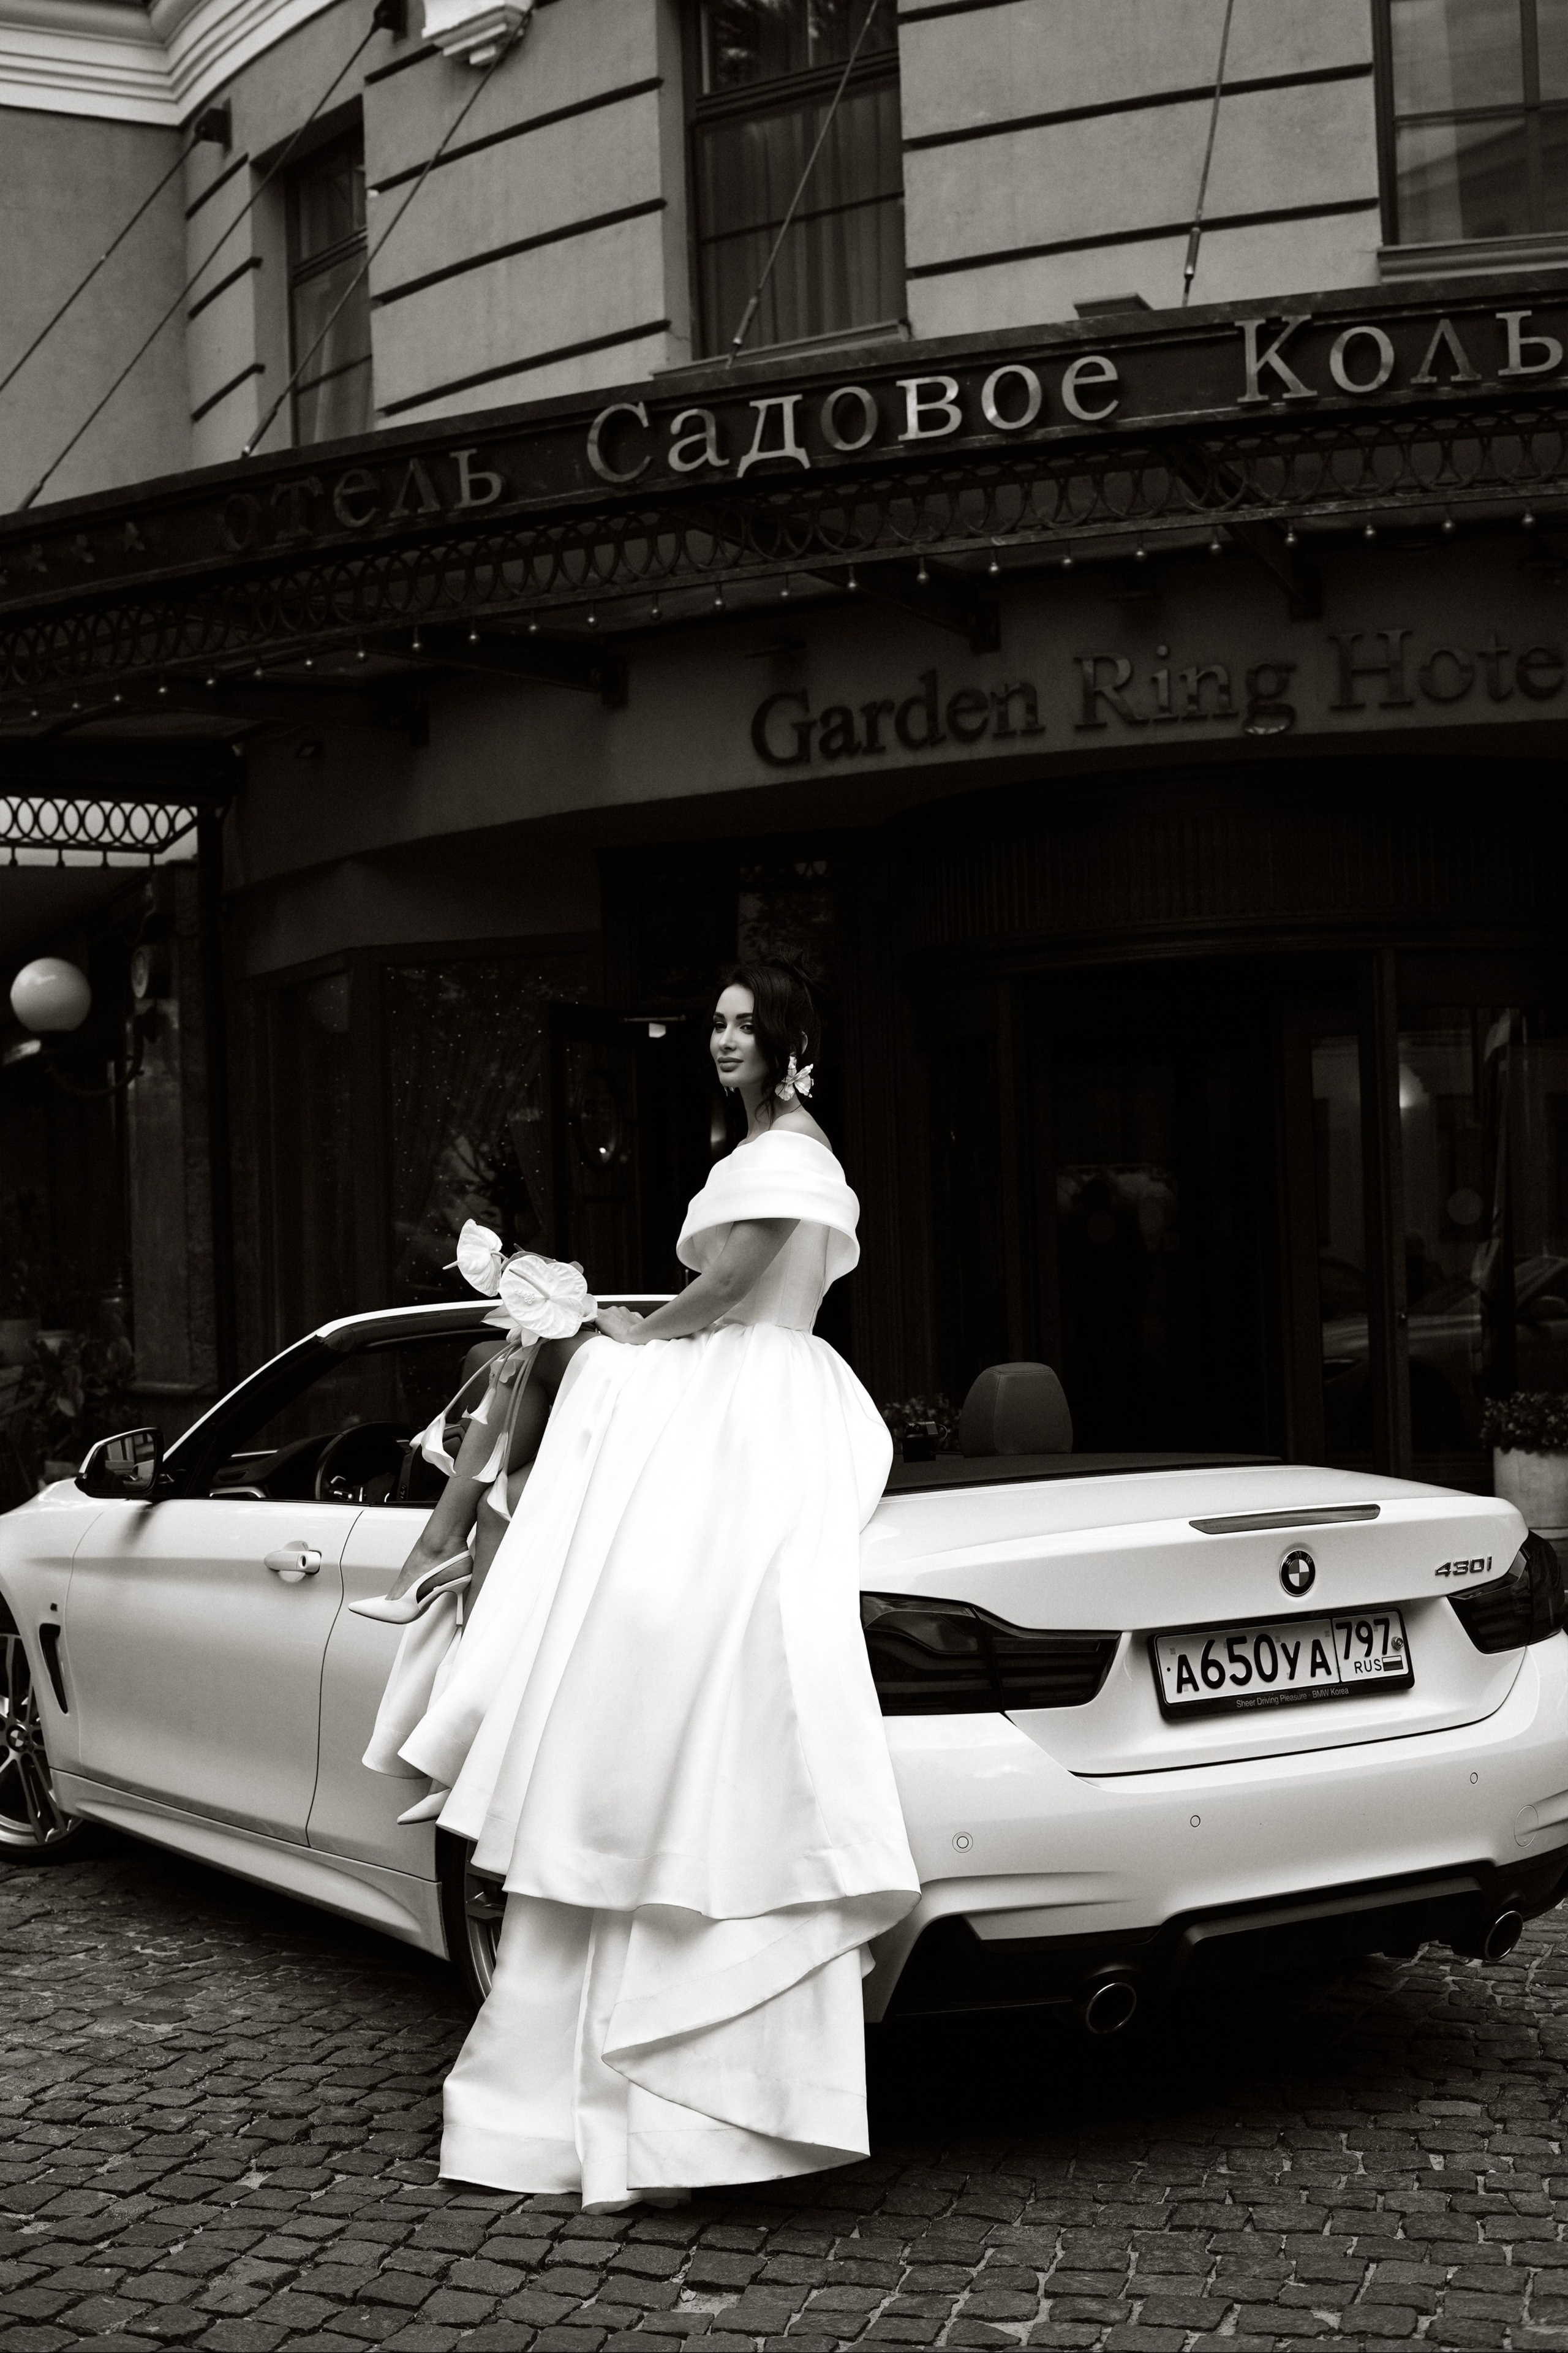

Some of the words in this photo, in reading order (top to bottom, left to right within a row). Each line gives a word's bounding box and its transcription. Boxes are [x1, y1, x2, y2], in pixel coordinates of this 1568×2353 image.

[586, 355, 1120, 483] Садовое
[1234, 310, 1564, 404] Коль
[751, 668, 1046, 766] Garden
[1073, 644, 1297, 735] Ring
[1328, 629, 1566, 711] Hote
[1434, 1556, 1492, 1577] 430i
[1335, 1617, 1390, 1660] 797
[1354, 1658, 1382, 1674] RUS
[1236, 1699, 1256, 1708] Sheer
[1257, 1696, 1279, 1705] Driving
[1280, 1693, 1307, 1702] Pleasure
[1312, 1689, 1329, 1698] BMW
[1330, 1687, 1349, 1696] Korea
